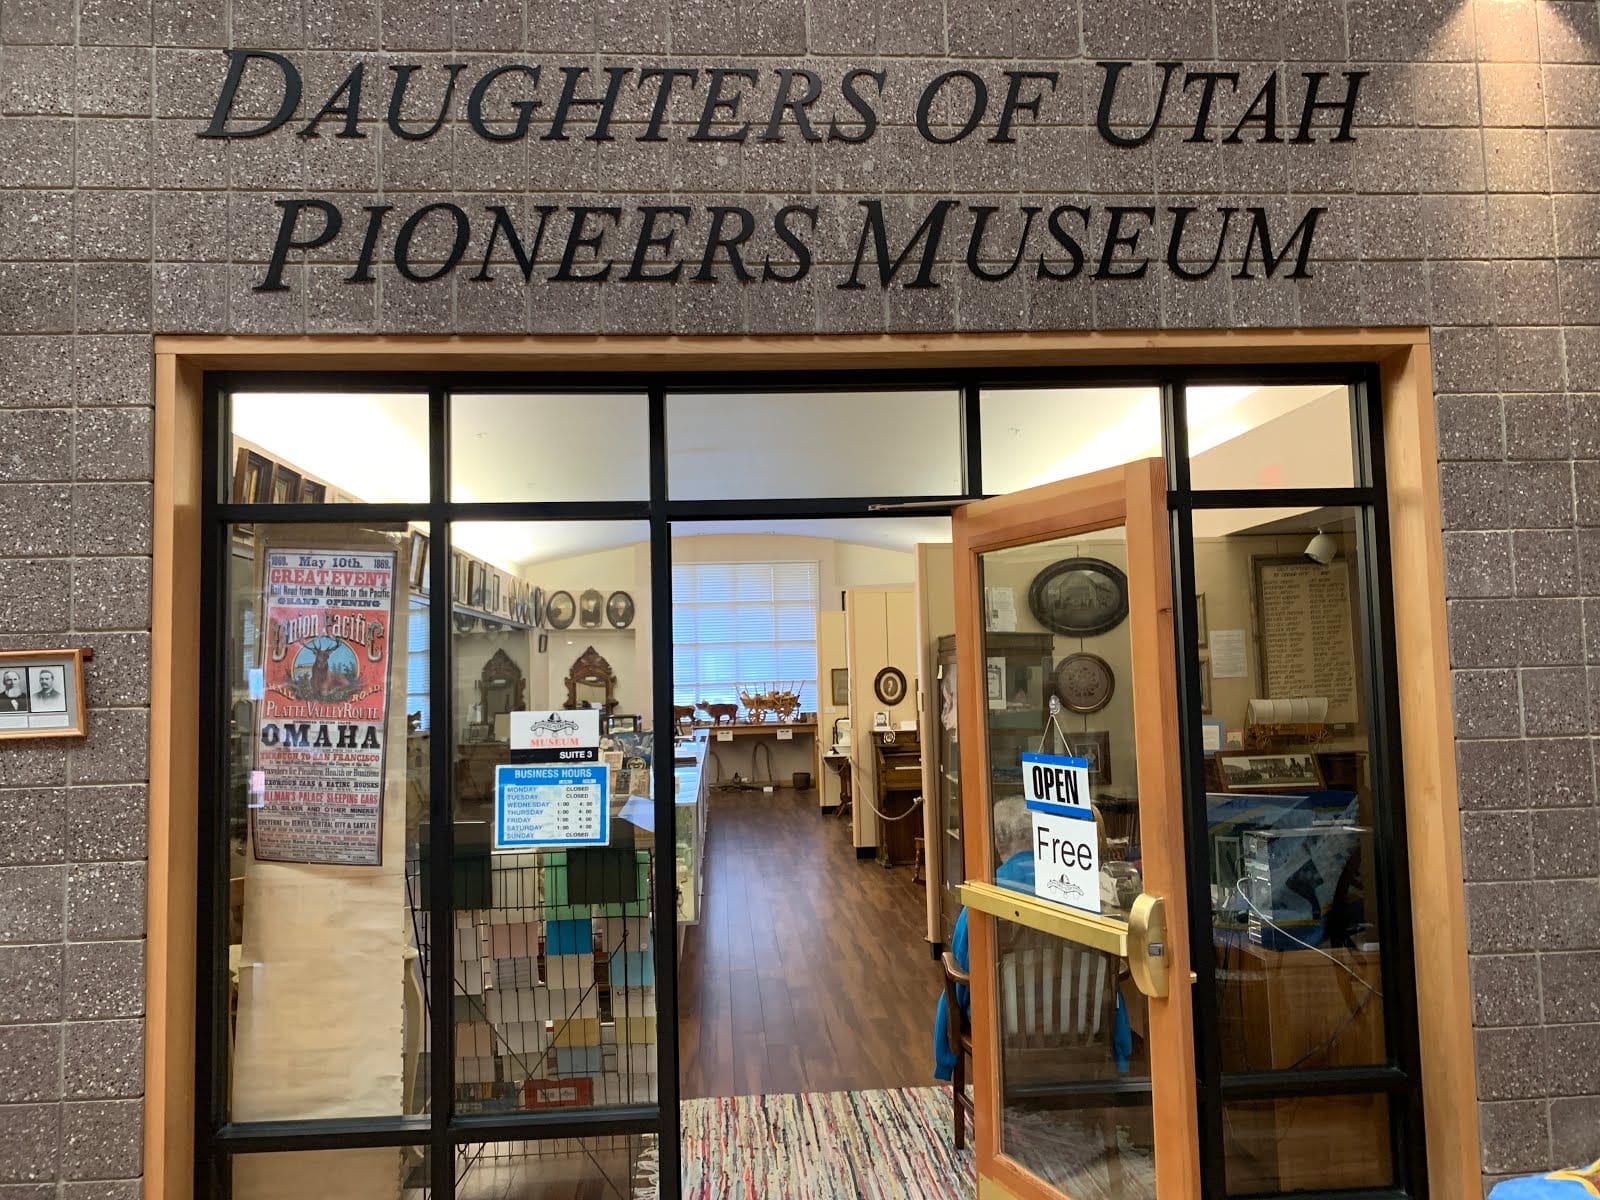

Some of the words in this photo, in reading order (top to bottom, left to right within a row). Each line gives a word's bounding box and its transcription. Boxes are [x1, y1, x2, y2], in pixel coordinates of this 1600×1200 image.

[196, 48, 888, 143] DAUGHTERS
[915, 69, 1059, 145] OF
[1096, 61, 1370, 147] UTAH
[252, 199, 819, 292] PIONEERS
[836, 199, 1328, 289] MUSEUM
[298, 556, 326, 569] May
[271, 568, 329, 586] GREAT
[331, 570, 391, 588] EVENT
[299, 585, 313, 597] from
[314, 586, 324, 596] the
[326, 586, 349, 598] Atlantic
[350, 588, 357, 598] to
[358, 588, 368, 598] the
[369, 587, 390, 599] Pacific
[277, 597, 320, 606] GRAND
[326, 598, 381, 608] OPENING
[272, 613, 319, 662] Union
[261, 723, 381, 749] OMAHA
[530, 737, 580, 746] MUSEUM
[301, 752, 311, 760] TO
[312, 752, 330, 761] SAN
[333, 753, 380, 762] FRANCISCO
[559, 751, 585, 759] SUITE
[587, 750, 593, 758] 3
[514, 769, 559, 779] BUSINESS
[561, 768, 592, 778] HOURS
[1032, 765, 1080, 805] OPEN
[298, 791, 323, 802] PALACE
[326, 792, 358, 804] SLEEPING
[360, 793, 378, 804] CARS
[1037, 826, 1093, 871] Free
